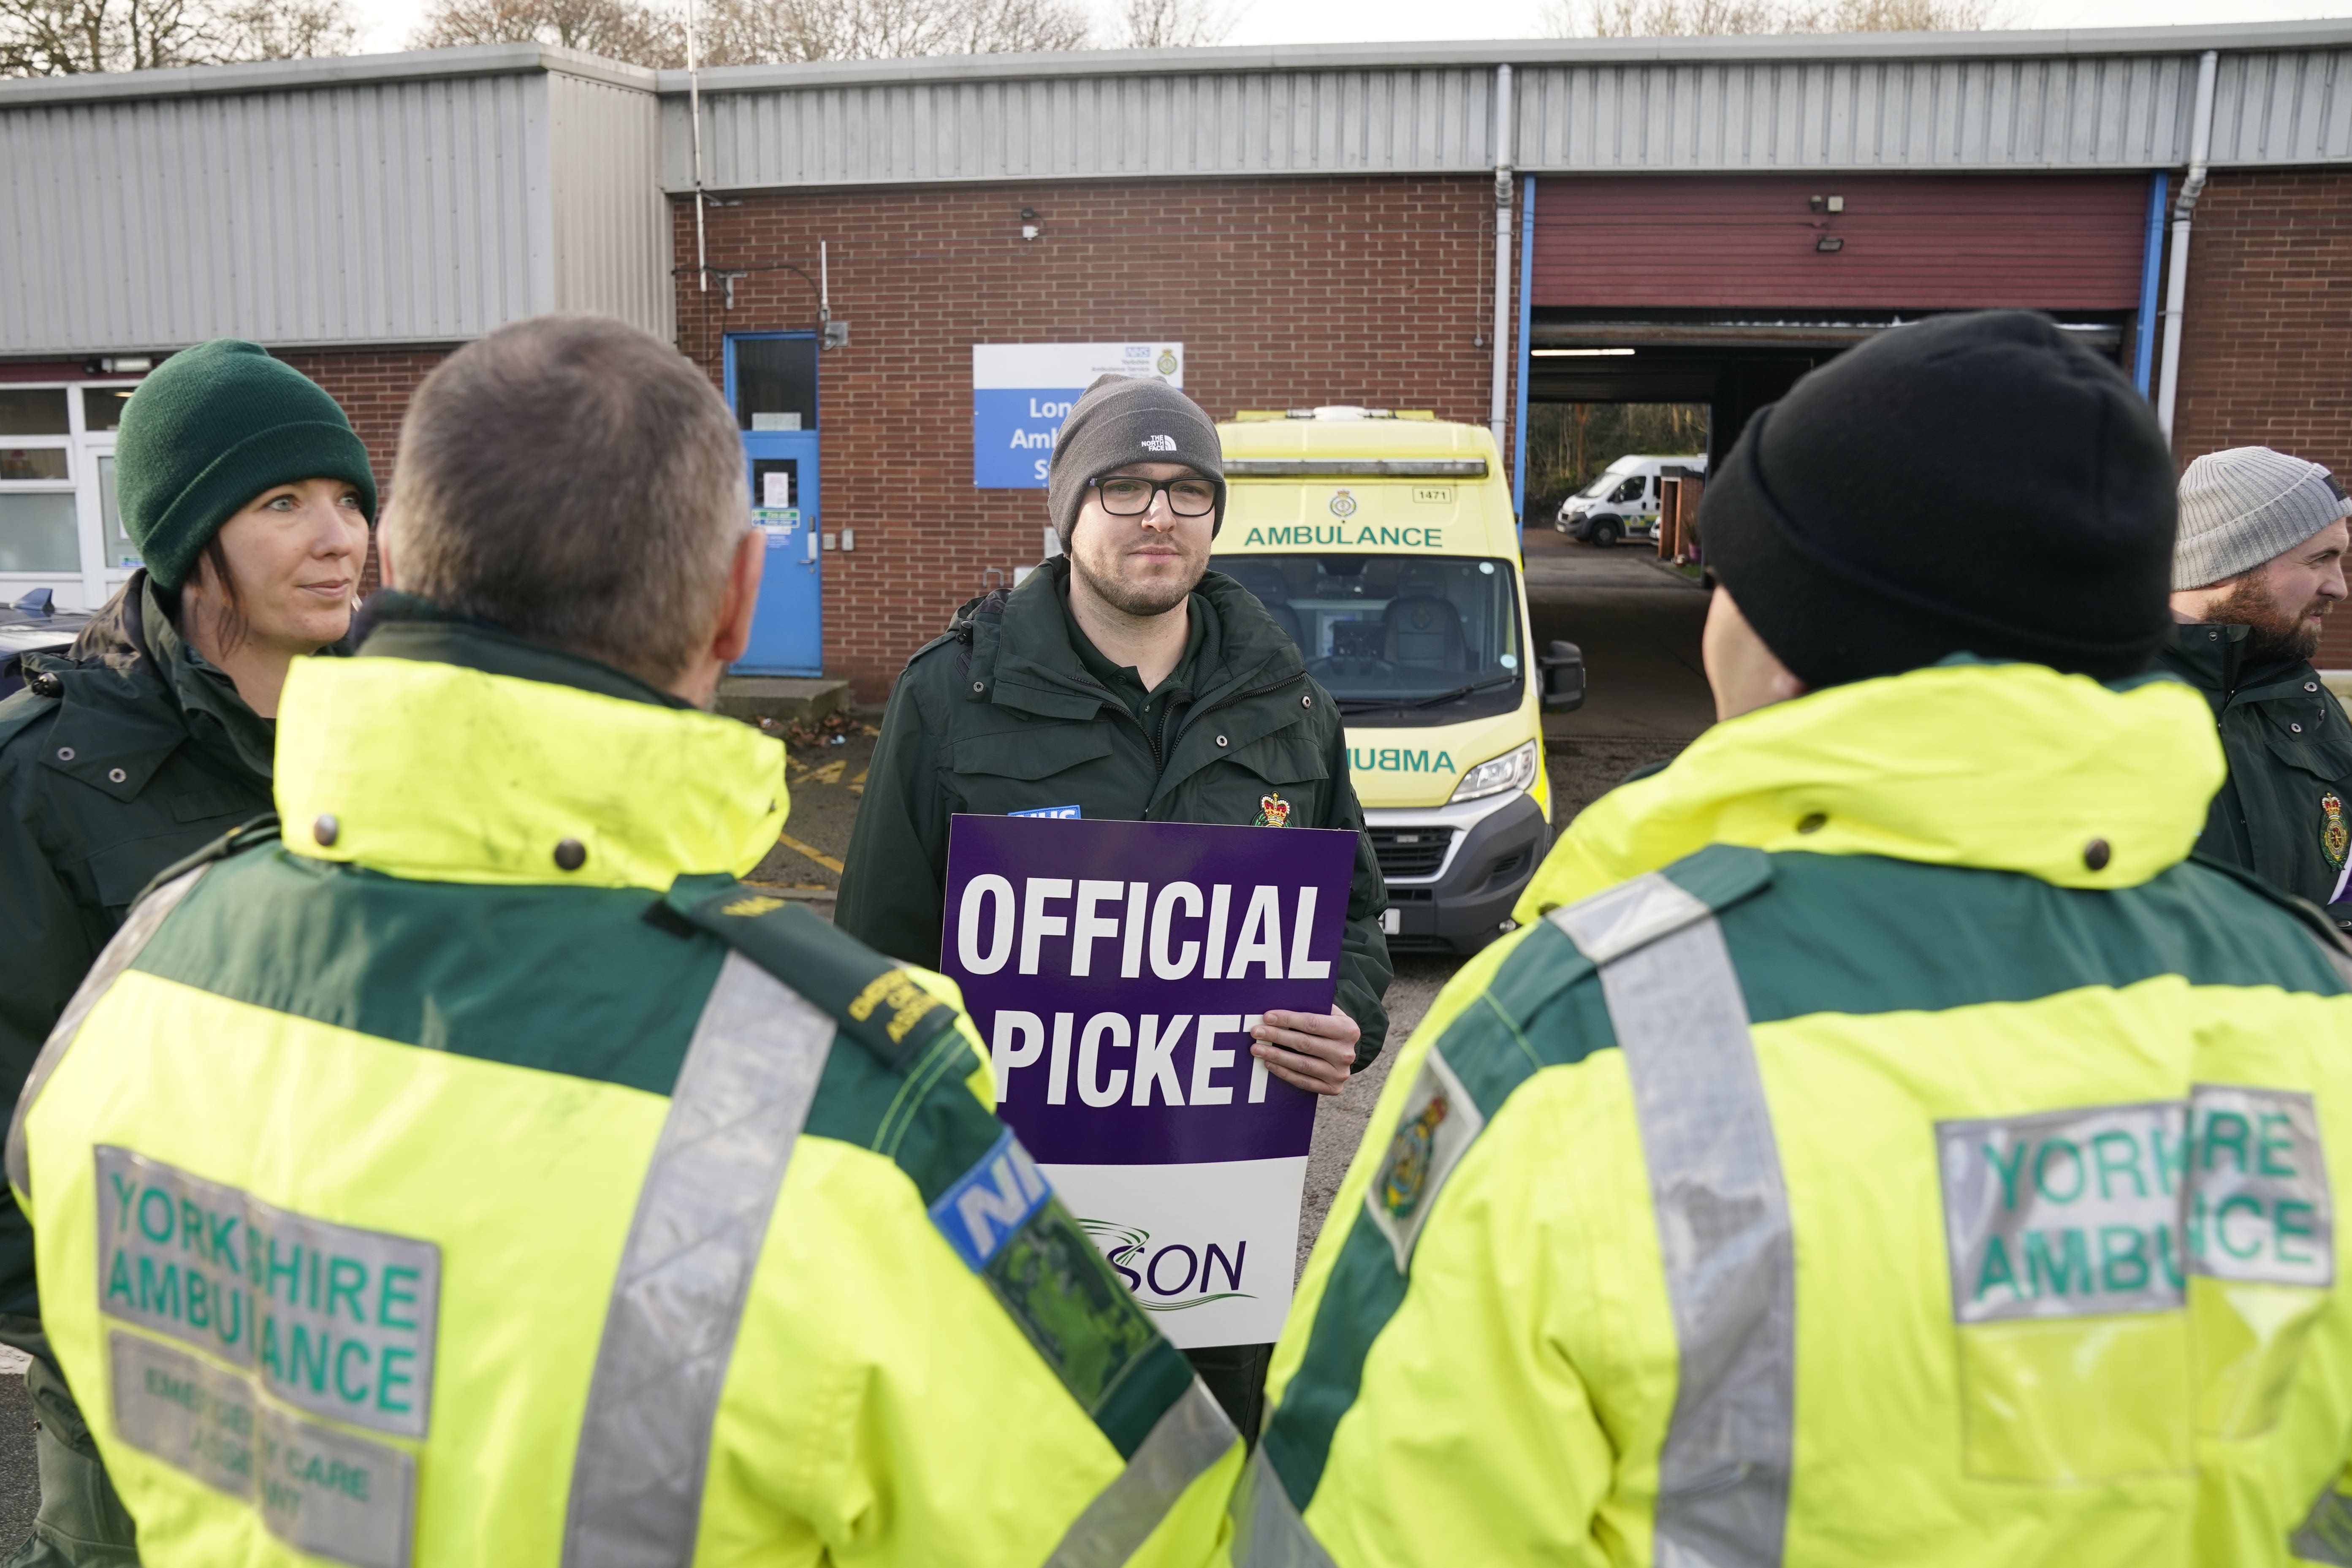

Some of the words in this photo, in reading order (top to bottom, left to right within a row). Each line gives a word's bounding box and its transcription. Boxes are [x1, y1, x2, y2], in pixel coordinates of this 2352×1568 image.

[1035, 458, 1049, 480] S
[1419, 491, 1446, 500] 1471
[1245, 526, 1443, 548] AMBULANCE
[958, 874, 1331, 980] OFFICIAL
[992, 1010, 1272, 1108] PICKET
[1098, 1240, 1246, 1296] SON
[284, 1448, 372, 1503] CARE
